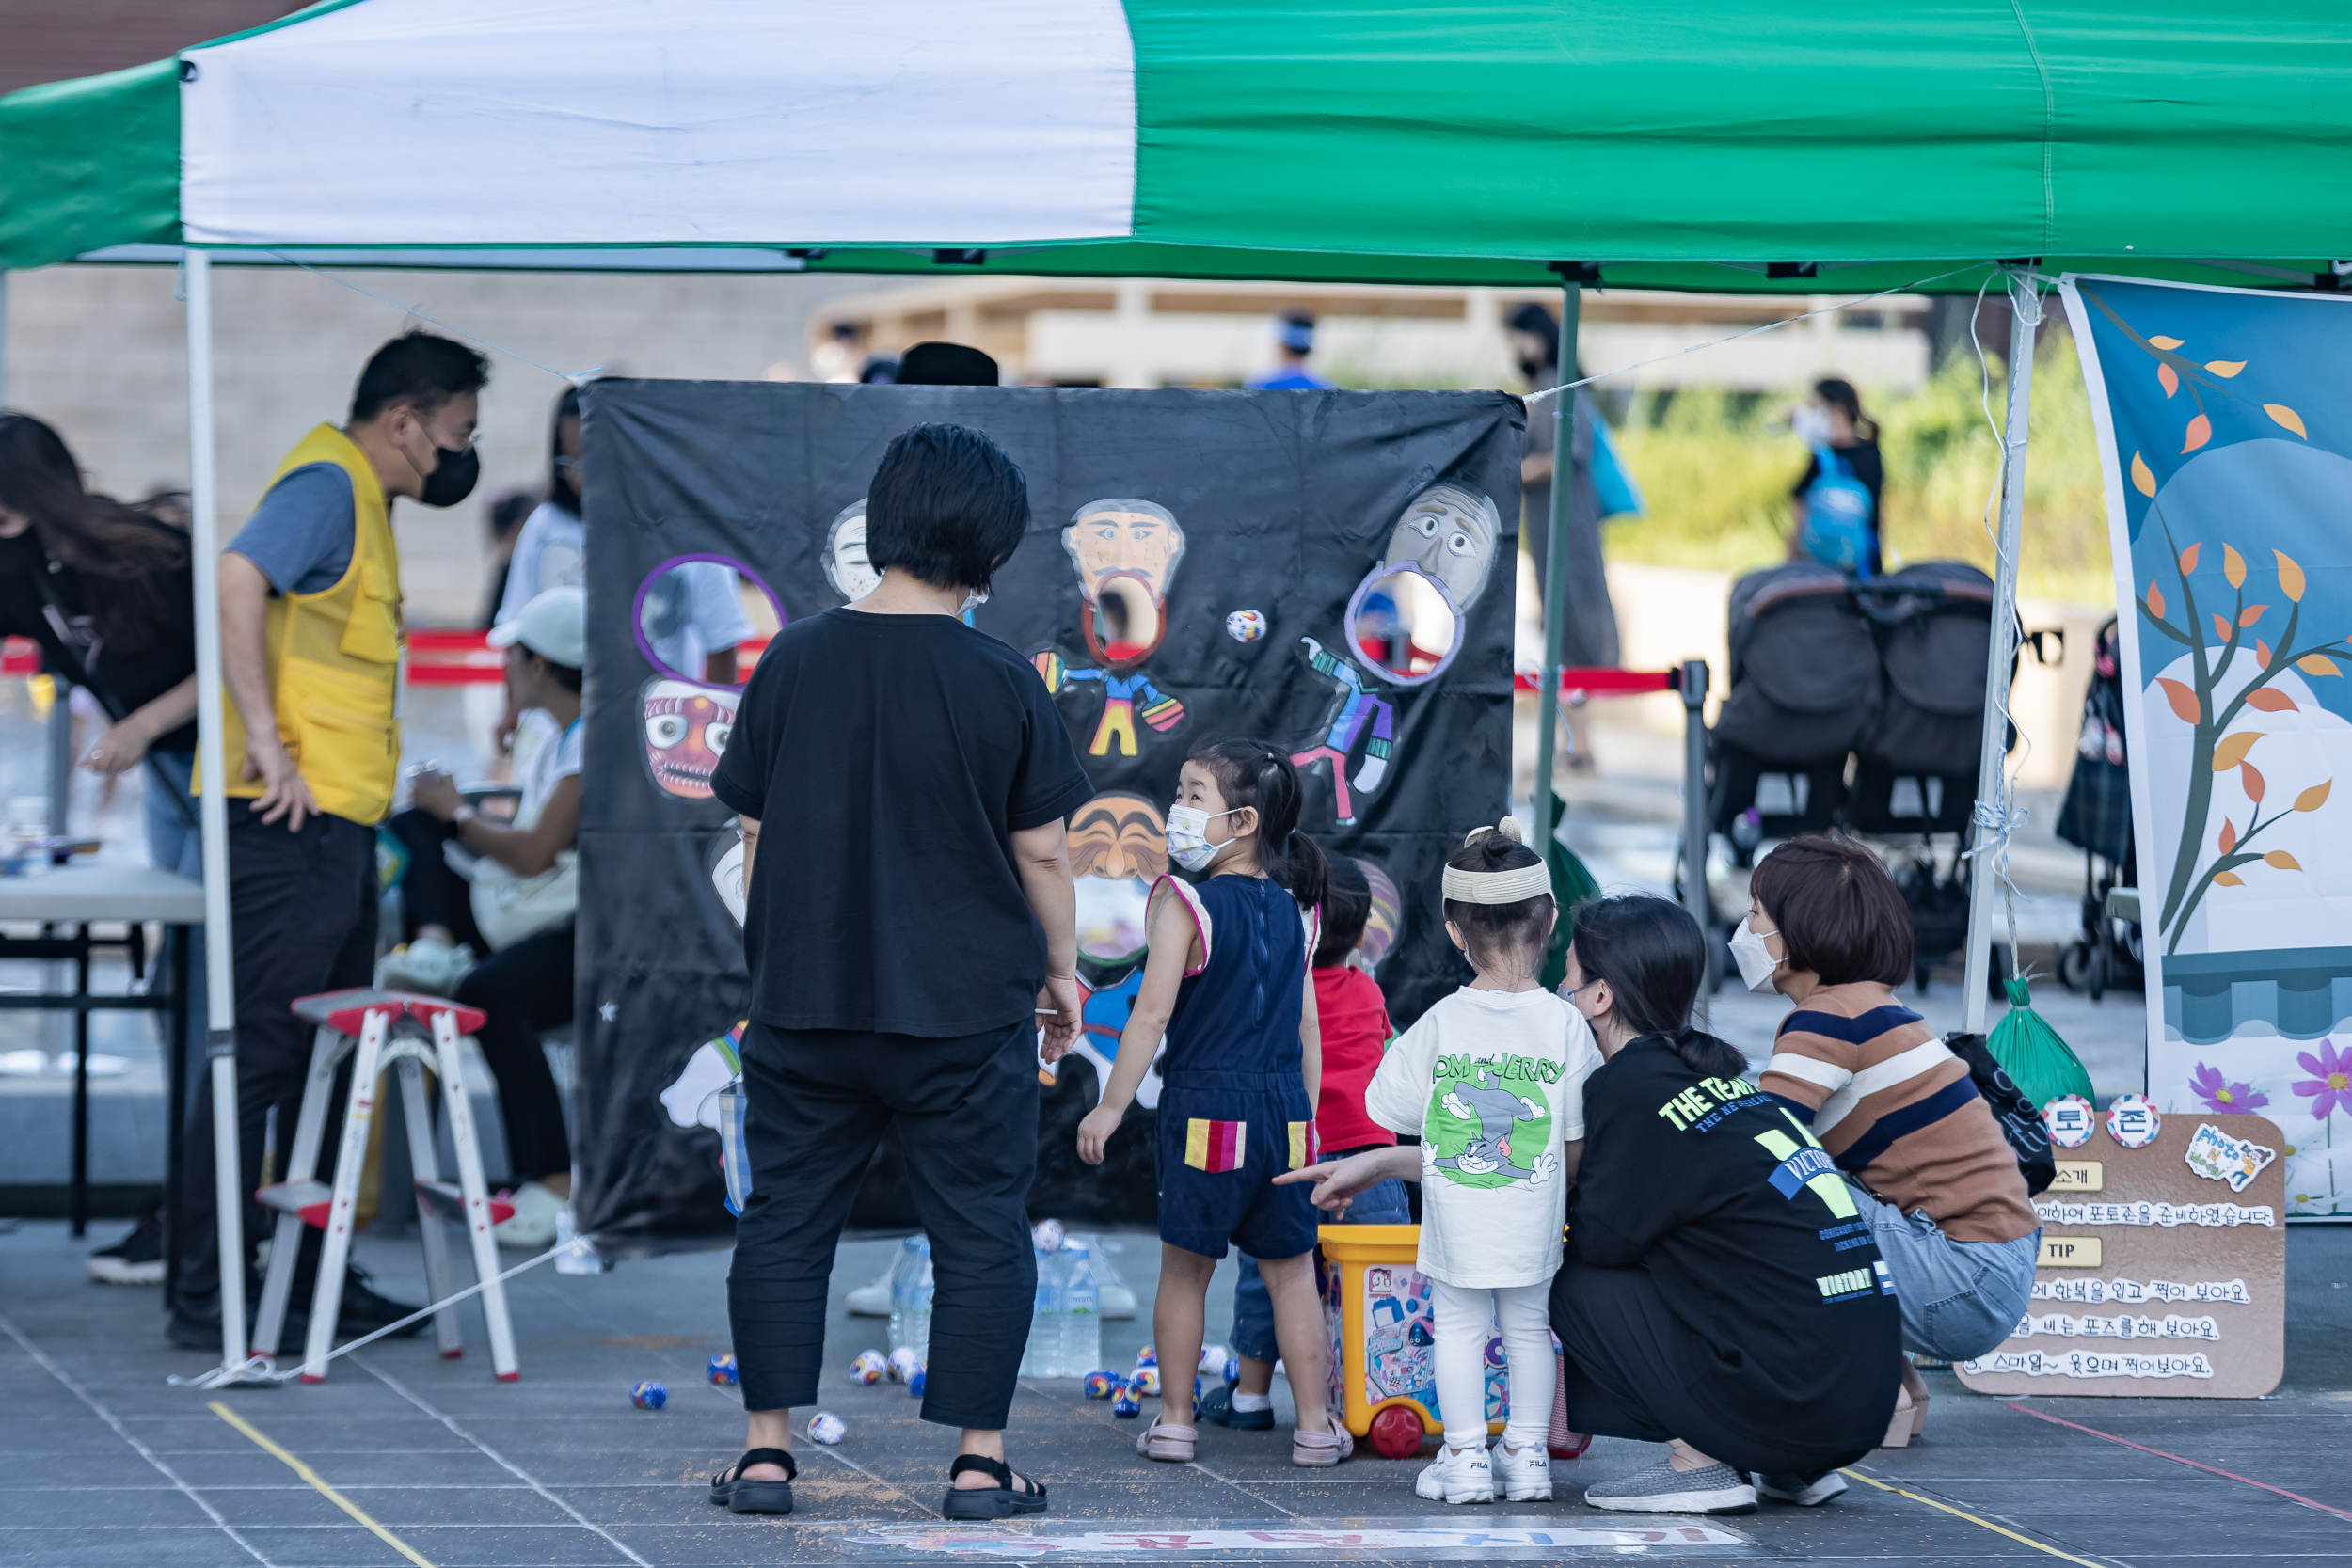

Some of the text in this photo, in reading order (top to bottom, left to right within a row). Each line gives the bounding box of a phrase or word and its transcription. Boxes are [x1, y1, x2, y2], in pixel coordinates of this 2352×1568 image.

[1492, 1053, 1566, 1085] JERRY
[1658, 1086, 1715, 1132] THE
[1695, 1113, 1723, 1132] THE
[2055, 1169, 2088, 1184] 소개
[2089, 1203, 2151, 1225] 포토존을
[2157, 1204, 2273, 1225] 준비하였습니다.
[2047, 1243, 2075, 1259] TIP
[1816, 1267, 1873, 1297] VICTORY
[2055, 1280, 2104, 1302] 한복을
[2111, 1281, 2143, 1300] 입고
[2153, 1281, 2185, 1300] 찍어
[2195, 1283, 2249, 1302] 보아요.
[2043, 1316, 2074, 1336] 비는
[2084, 1316, 2133, 1338] 포즈를
[2166, 1319, 2218, 1338] 보아요.
[2069, 1353, 2118, 1375] 웃으며
[1529, 1460, 1547, 1468] FILA
